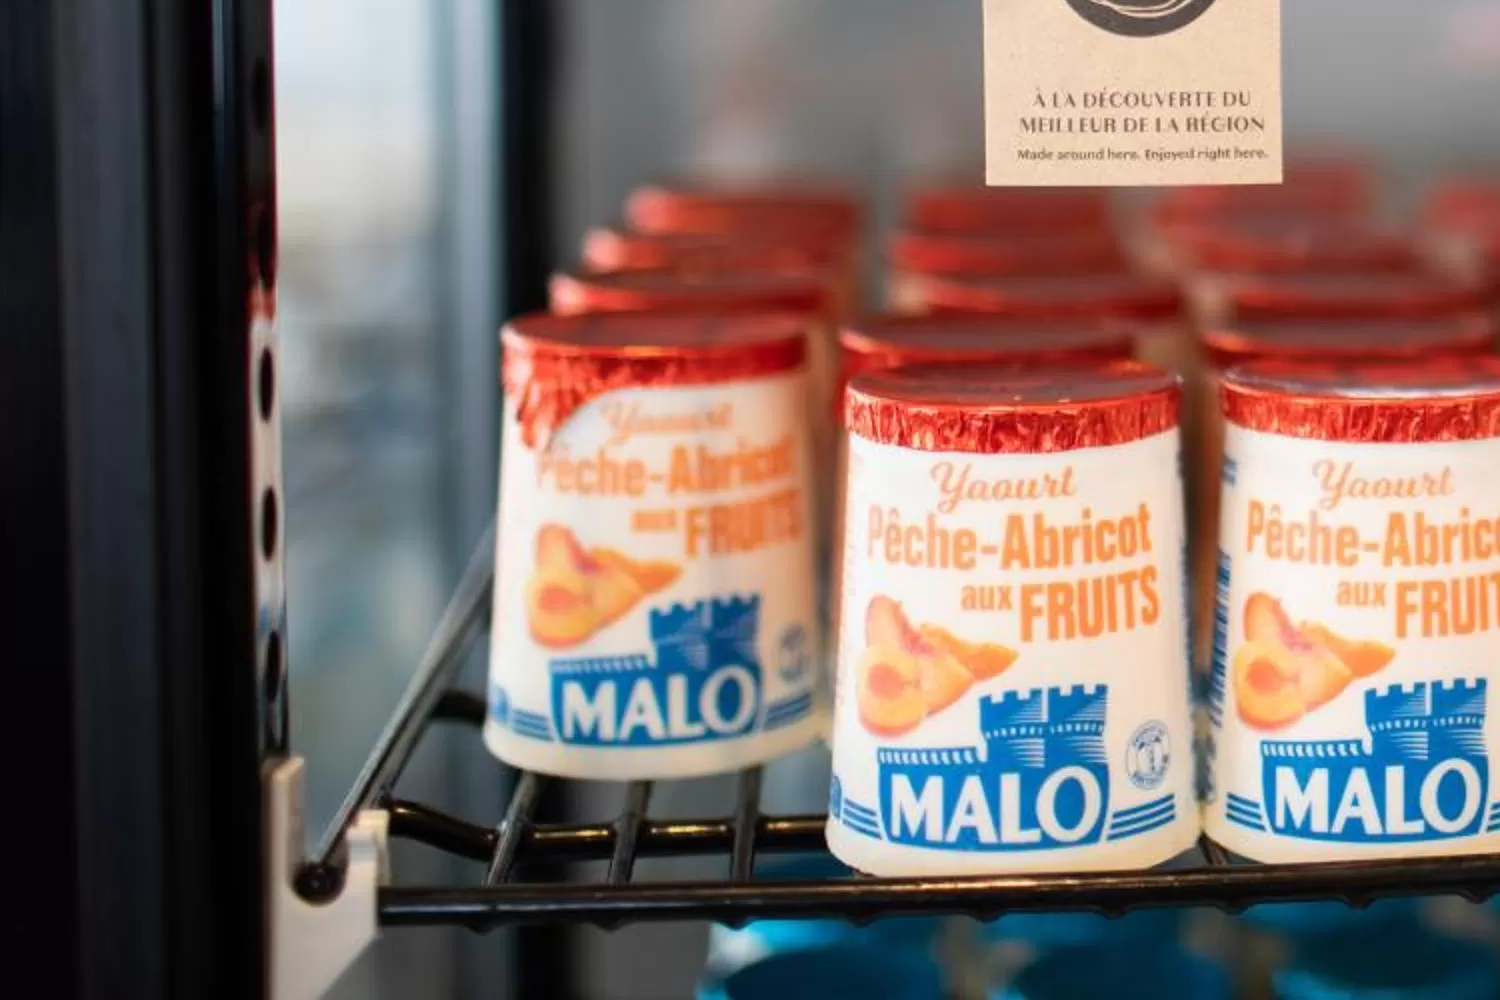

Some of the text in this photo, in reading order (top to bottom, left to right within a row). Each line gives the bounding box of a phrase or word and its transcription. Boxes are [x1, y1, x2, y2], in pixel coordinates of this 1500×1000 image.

[1020, 111, 1265, 133] MEILLEUR DE LA RÉGION
[1033, 86, 1251, 108] À LA DÉCOUVERTE DU
[1018, 147, 1269, 162] Made around here. Enjoyed right here.
[930, 461, 1078, 513] Yaourt
[1312, 458, 1455, 510] Yaourt
[867, 502, 1152, 571] Pêche-Abricot
[961, 565, 1158, 643] aux FRUITS
[1337, 581, 1385, 607] aux
[562, 665, 755, 742] MALO
[891, 765, 1101, 845] MALO
[1275, 757, 1482, 835] MALO
